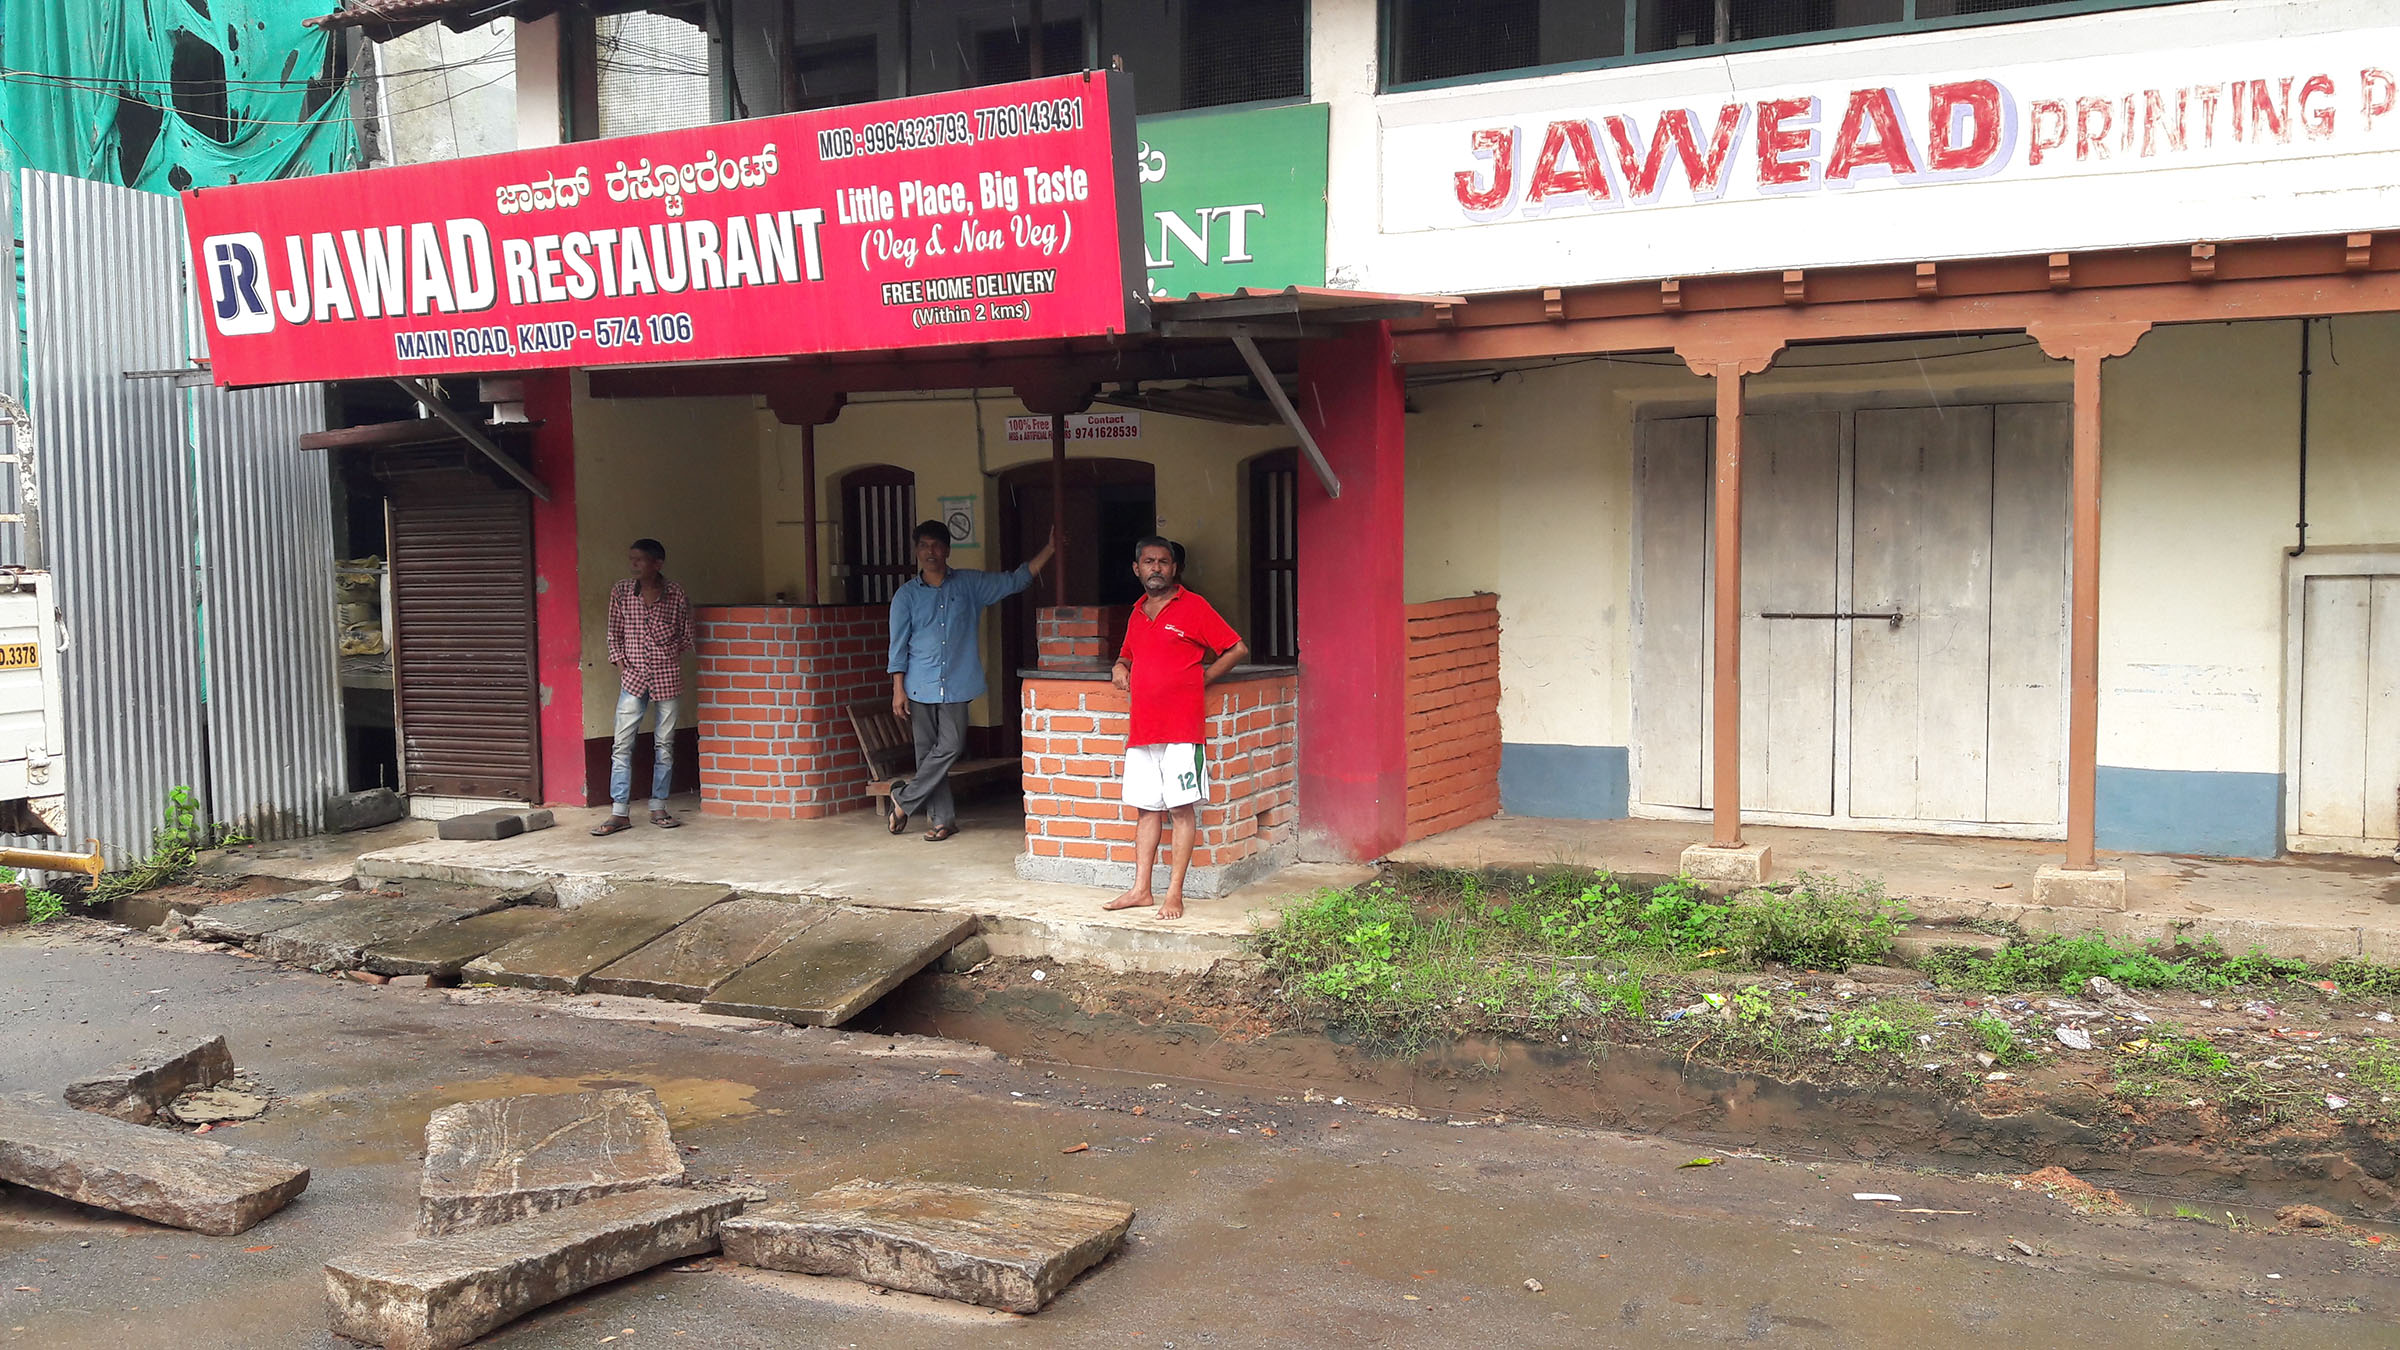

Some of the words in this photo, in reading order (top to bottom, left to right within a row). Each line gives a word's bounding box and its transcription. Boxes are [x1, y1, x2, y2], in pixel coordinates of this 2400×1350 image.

[975, 97, 1083, 141] 7760143431
[1454, 78, 2005, 213] JAWEAD
[2029, 74, 2336, 167] PRINTING
[2360, 67, 2396, 132] P
[495, 167, 591, 216] ಜಾವದ್
[836, 184, 895, 225] Little
[899, 179, 975, 219] Place,
[978, 170, 1019, 212] Big
[1023, 164, 1089, 204] Taste
[860, 228, 919, 271] (Veg
[925, 223, 946, 256] &
[953, 219, 1005, 254] Non
[1010, 209, 1073, 256] Veg)
[275, 217, 497, 325] JAWAD
[501, 207, 825, 306] RESTAURANT
[881, 281, 924, 306] FREE
[925, 276, 974, 302] HOME
[975, 268, 1057, 298] DELIVERY
[394, 331, 449, 360] MAIN
[451, 326, 516, 357] ROAD,
[516, 320, 577, 351] KAUP
[594, 315, 643, 348] 574
[646, 311, 693, 344] 106
[912, 306, 972, 329] (Within
[974, 303, 988, 322] 2
[990, 300, 1031, 322] kms)
[1008, 419, 1031, 431] 100%
[1032, 418, 1050, 429] Free
[1075, 425, 1138, 440] 9741628539
[1087, 415, 1125, 425] Contact
[1177, 771, 1196, 791] 12
